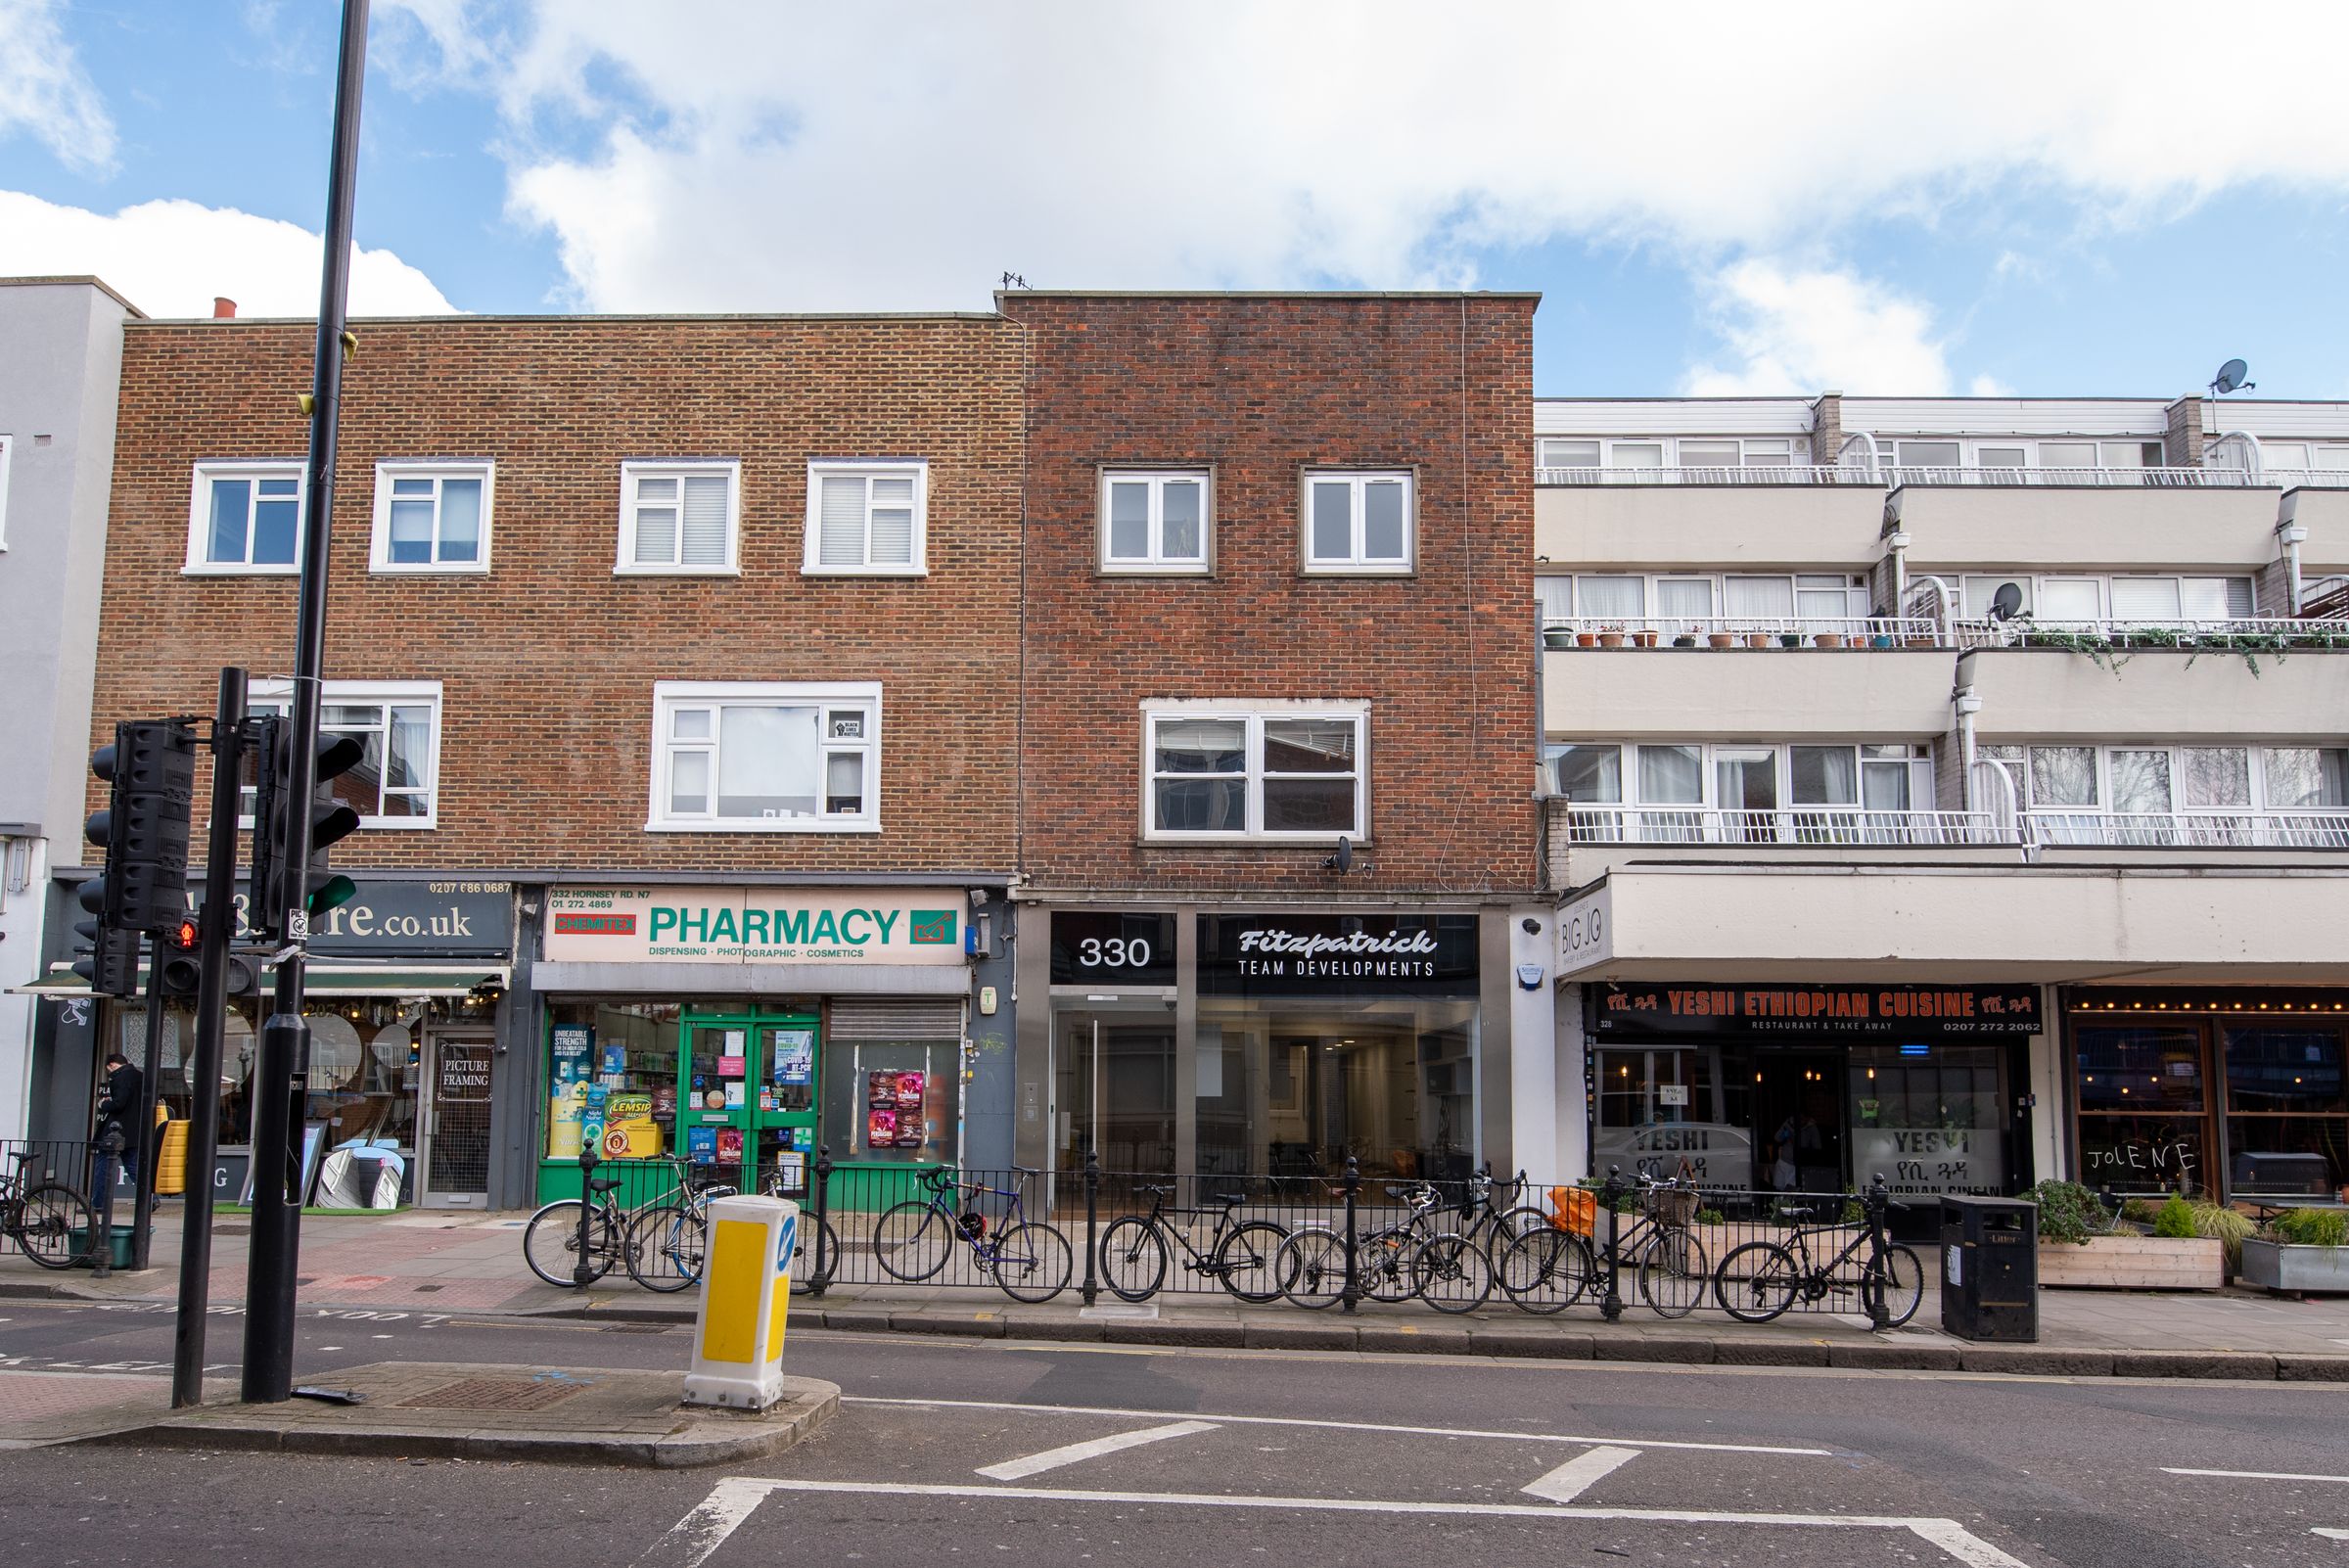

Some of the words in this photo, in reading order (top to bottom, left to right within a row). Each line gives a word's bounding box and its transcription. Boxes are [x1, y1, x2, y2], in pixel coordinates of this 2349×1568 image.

[429, 883, 457, 894] 0207
[460, 883, 482, 894] 686
[484, 883, 512, 894] 0687
[551, 890, 571, 899] 332
[572, 890, 618, 899] HORNSEY
[637, 891, 651, 899] N7
[588, 899, 613, 908] 4869
[555, 916, 635, 931] CHEMITEX
[649, 906, 900, 945] PHARMACY
[1562, 917, 1582, 955] BIG
[1585, 907, 1602, 945] JO
[1238, 929, 1438, 959] Fitzpatrick
[648, 946, 707, 956] DISPENSING
[716, 947, 797, 958] PHOTOGRAPHIC
[806, 948, 864, 958] COSMETICS
[1079, 938, 1150, 967] 330
[1238, 960, 1284, 975] TEAM
[1297, 960, 1434, 977] DEVELOPMENTS
[1667, 990, 1735, 1016] YESHI
[1743, 991, 1869, 1018] ETHIOPIAN
[1878, 992, 1975, 1017] CUISINE
[1599, 1020, 1613, 1029] 328
[1751, 1021, 1818, 1030] RESTAURANT
[1865, 1022, 1893, 1031] AWAY
[1943, 1023, 1975, 1032] 0207
[1980, 1023, 2004, 1032] 272
[2008, 1023, 2041, 1032] 2062
[554, 1038, 587, 1046] STRENGTH
[445, 1060, 489, 1072] PICTURE
[443, 1075, 488, 1086] FRAMING
[1634, 1130, 1709, 1151] YESHI
[2087, 1143, 2195, 1170] JOLENE
[1992, 1234, 2016, 1243] Litter
